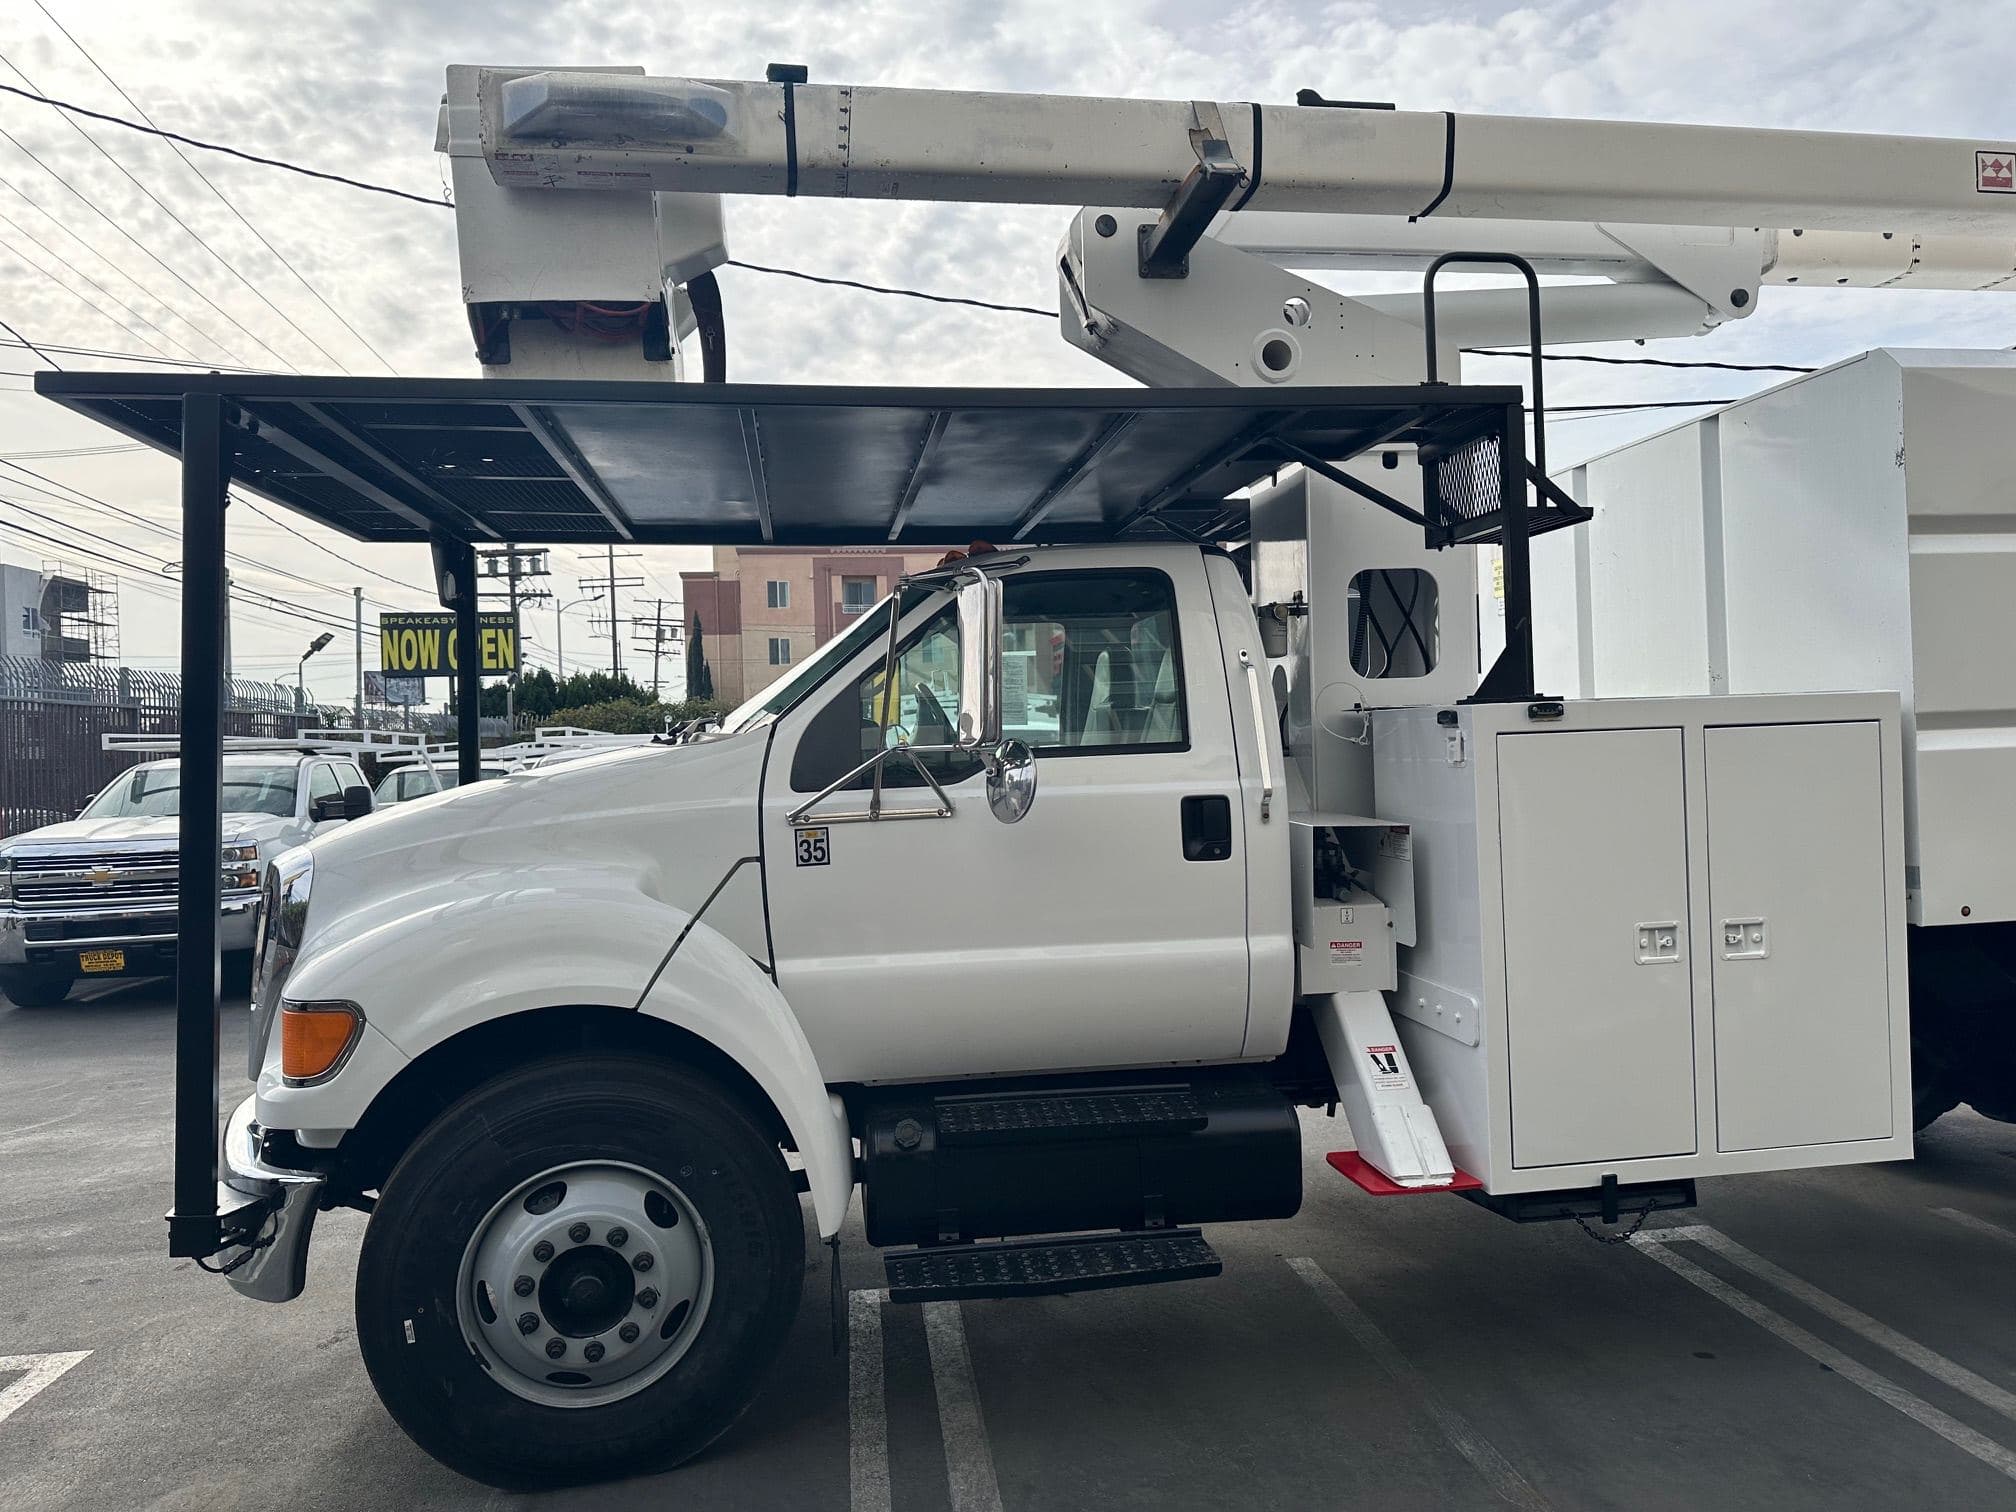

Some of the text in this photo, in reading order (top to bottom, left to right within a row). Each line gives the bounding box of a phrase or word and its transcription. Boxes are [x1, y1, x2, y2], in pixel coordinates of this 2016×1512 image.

[381, 616, 456, 625] SPEAKEASY
[382, 628, 515, 670] NOW OEN
[799, 838, 826, 863] 35
